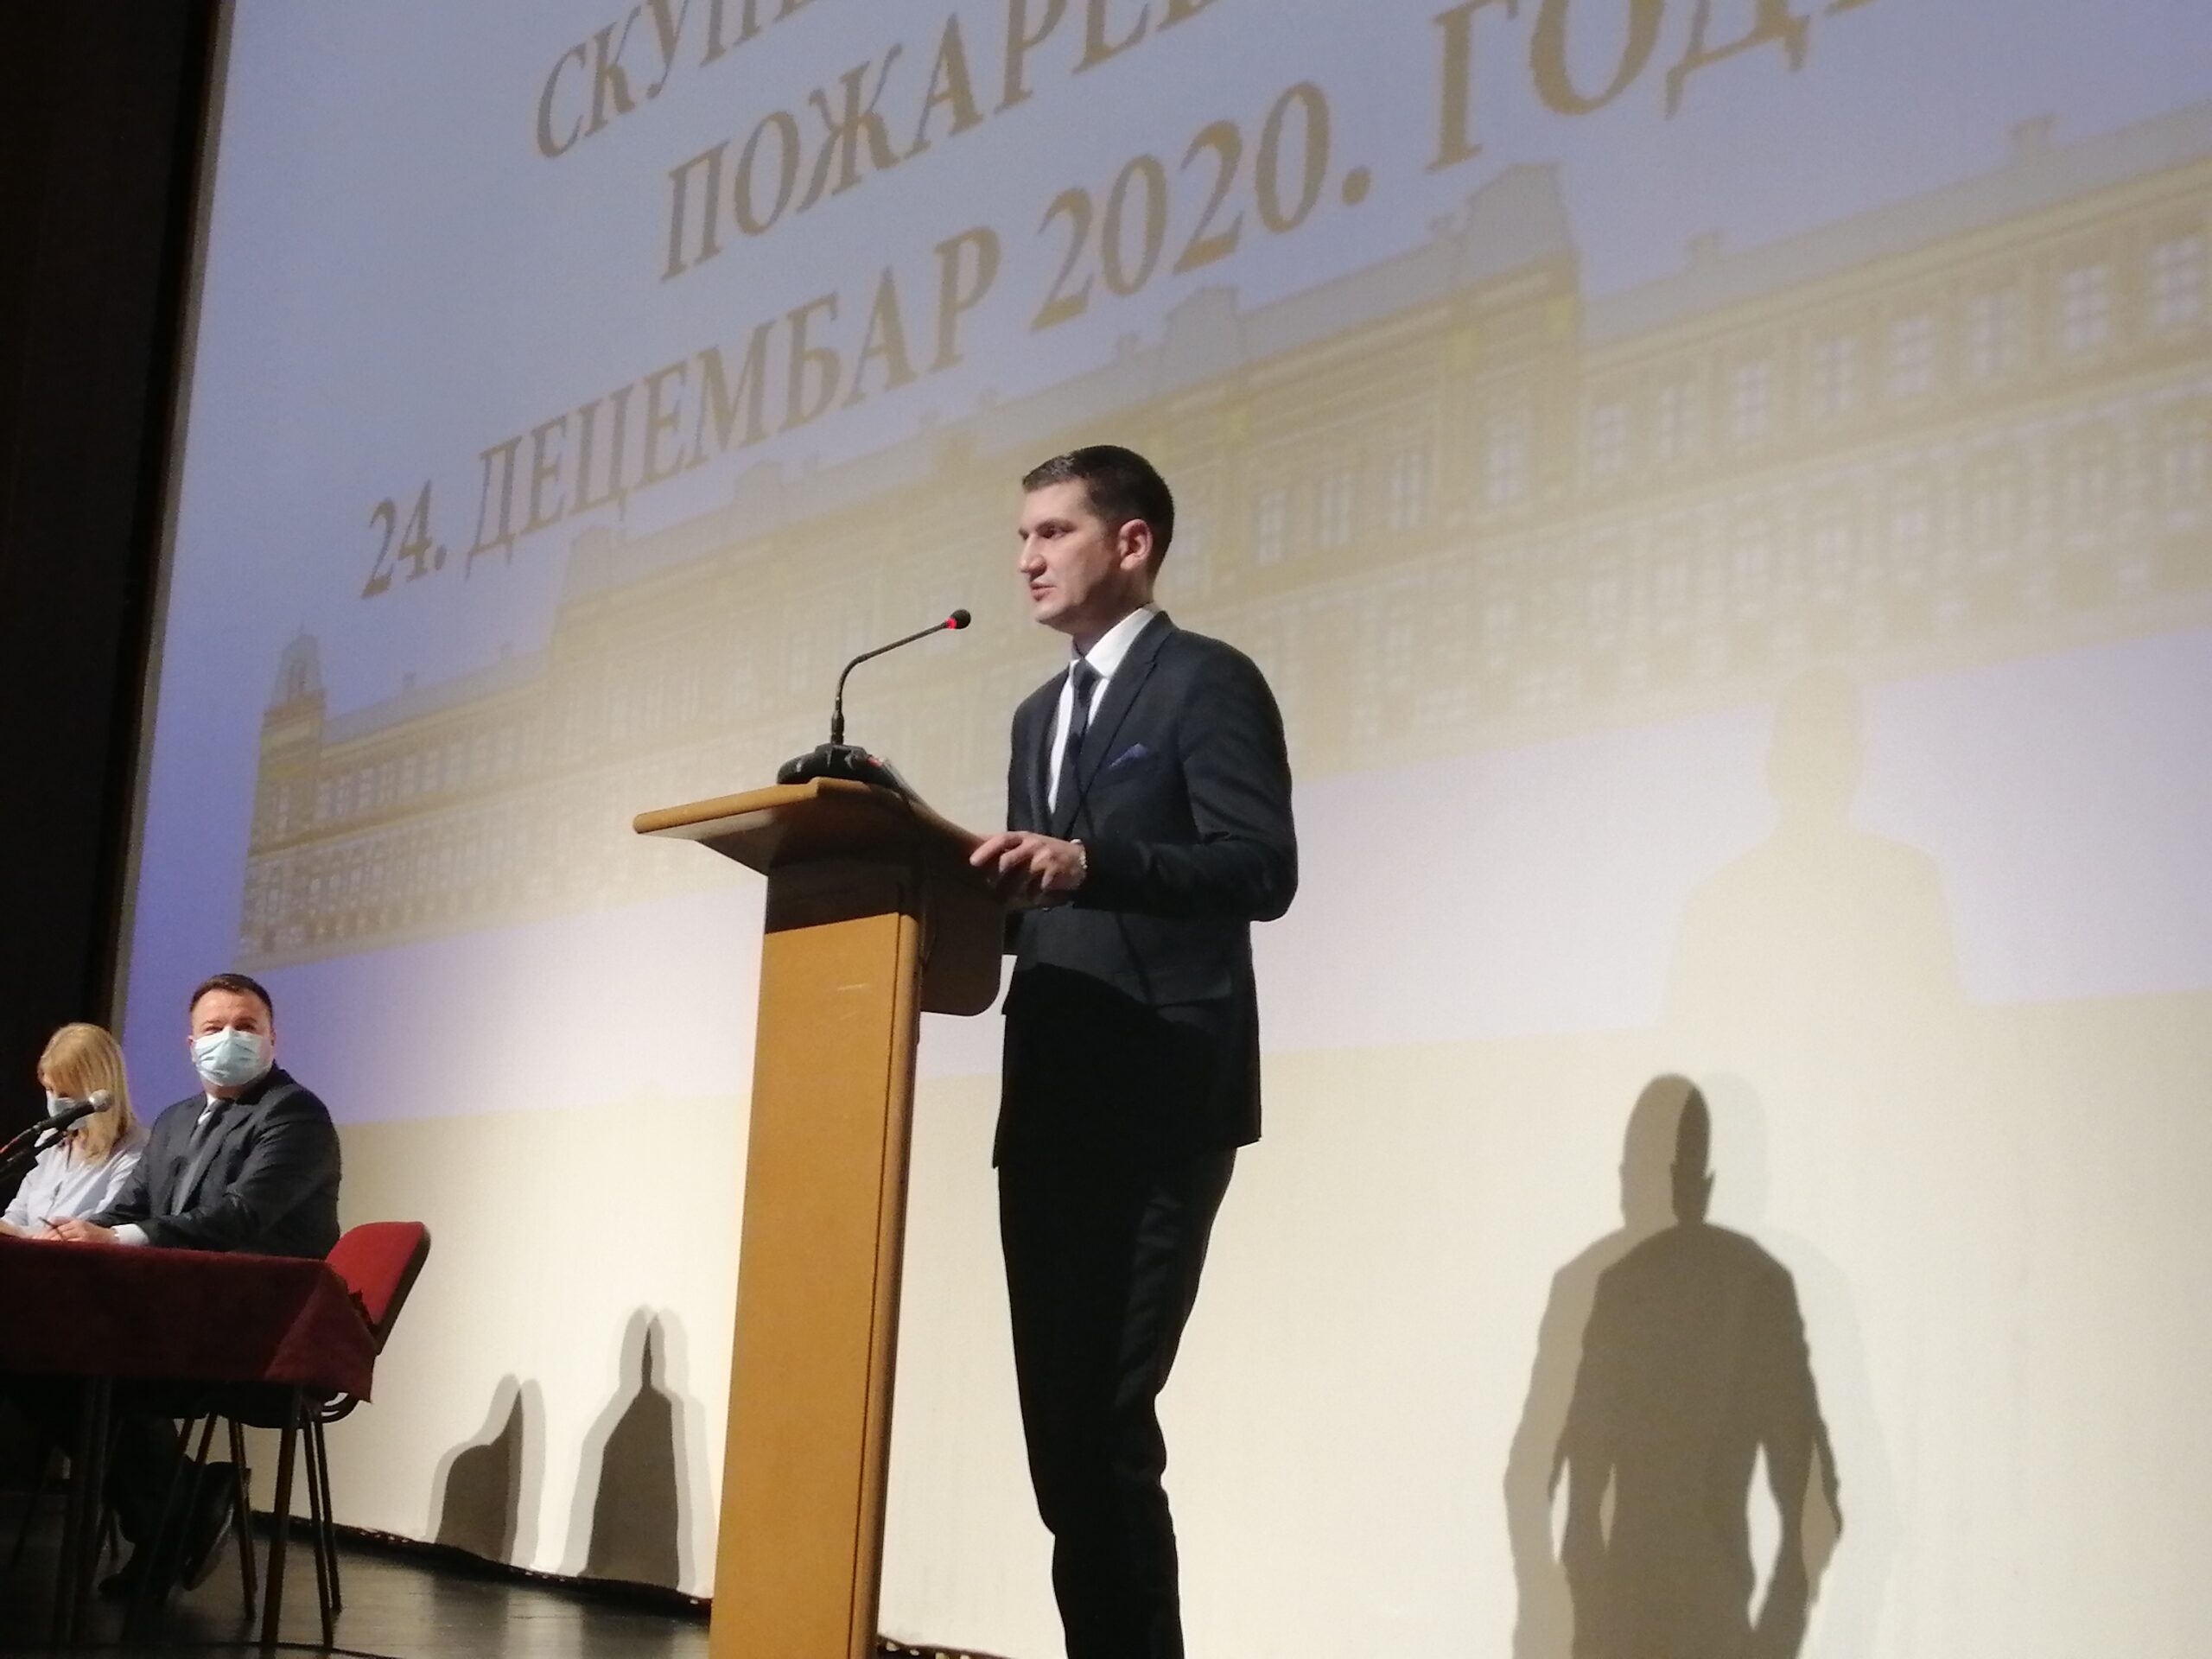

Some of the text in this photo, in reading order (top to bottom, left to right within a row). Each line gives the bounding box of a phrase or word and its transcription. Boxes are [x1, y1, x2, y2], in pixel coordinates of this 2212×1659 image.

[535, 0, 817, 159] СКУ
[660, 0, 1214, 283] ПОЖАР
[361, 0, 1879, 599] 24. ДЕЦЕМБАР 2020. ГО
